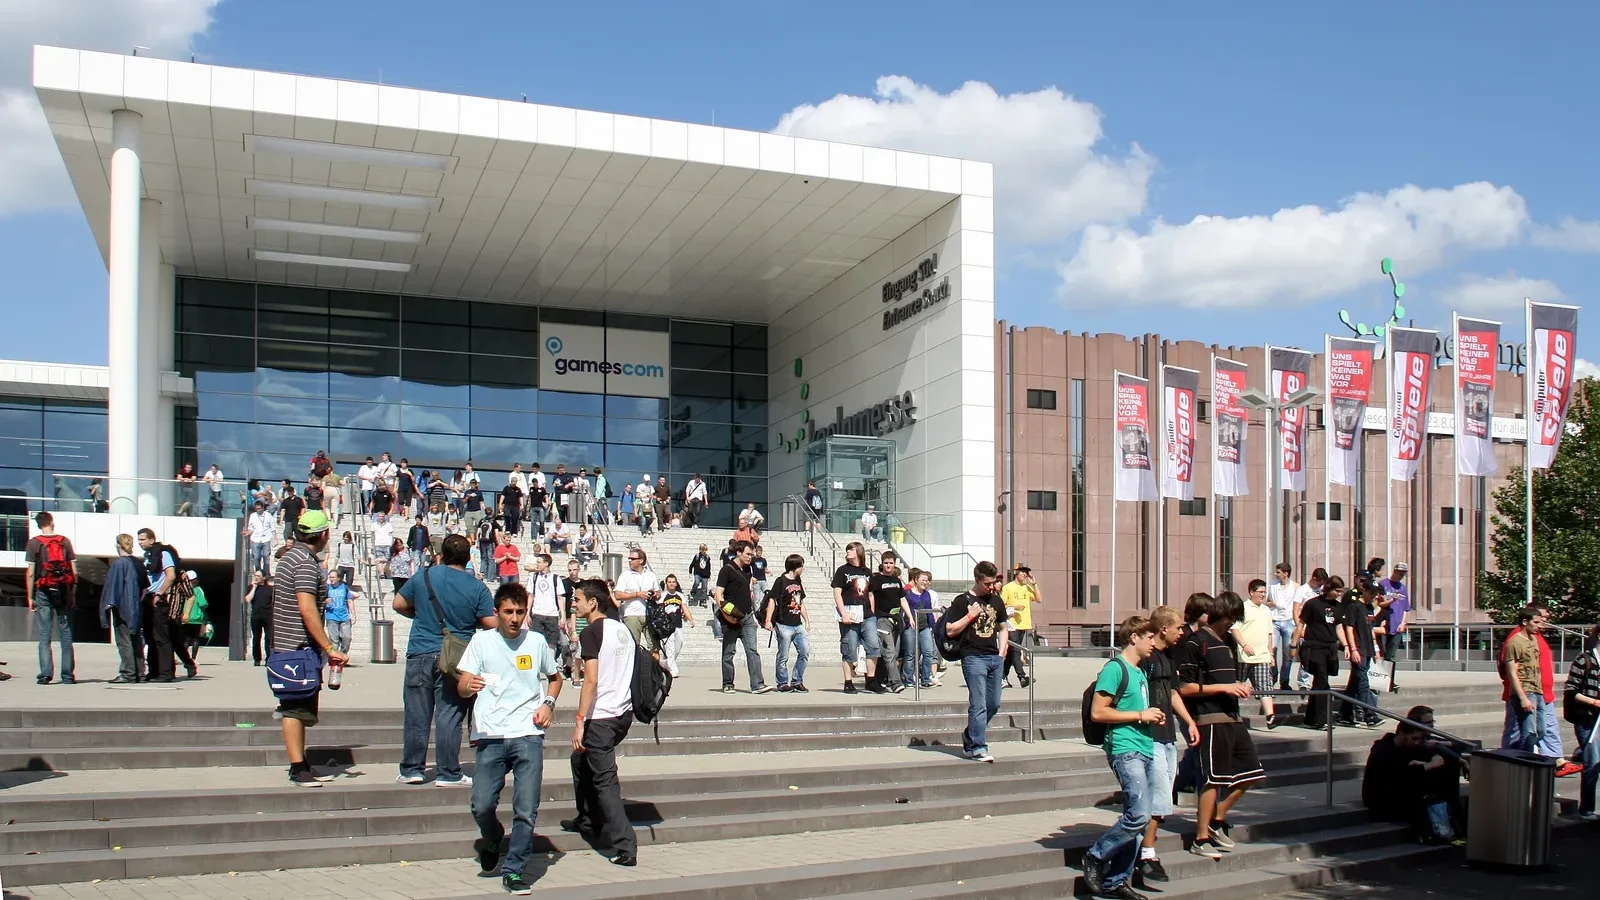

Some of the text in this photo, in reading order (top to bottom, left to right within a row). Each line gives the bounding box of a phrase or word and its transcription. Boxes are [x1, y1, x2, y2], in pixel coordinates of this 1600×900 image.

[882, 253, 938, 302] Eingang Süd
[882, 276, 952, 331] Entrance South
[1459, 335, 1478, 343] UNS
[1459, 342, 1488, 350] SPIELT
[1331, 360, 1361, 368] SPIELT
[1459, 349, 1489, 358] KEINER
[555, 357, 664, 378] gamescom
[1331, 367, 1364, 375] KEINER
[1544, 333, 1567, 438] Spiele
[1394, 391, 1402, 438] Computer
[1400, 356, 1424, 458] Spiele
[1428, 416, 1455, 429] 23.8.0
[1494, 421, 1507, 432] für
[1177, 391, 1191, 480] Spiele
